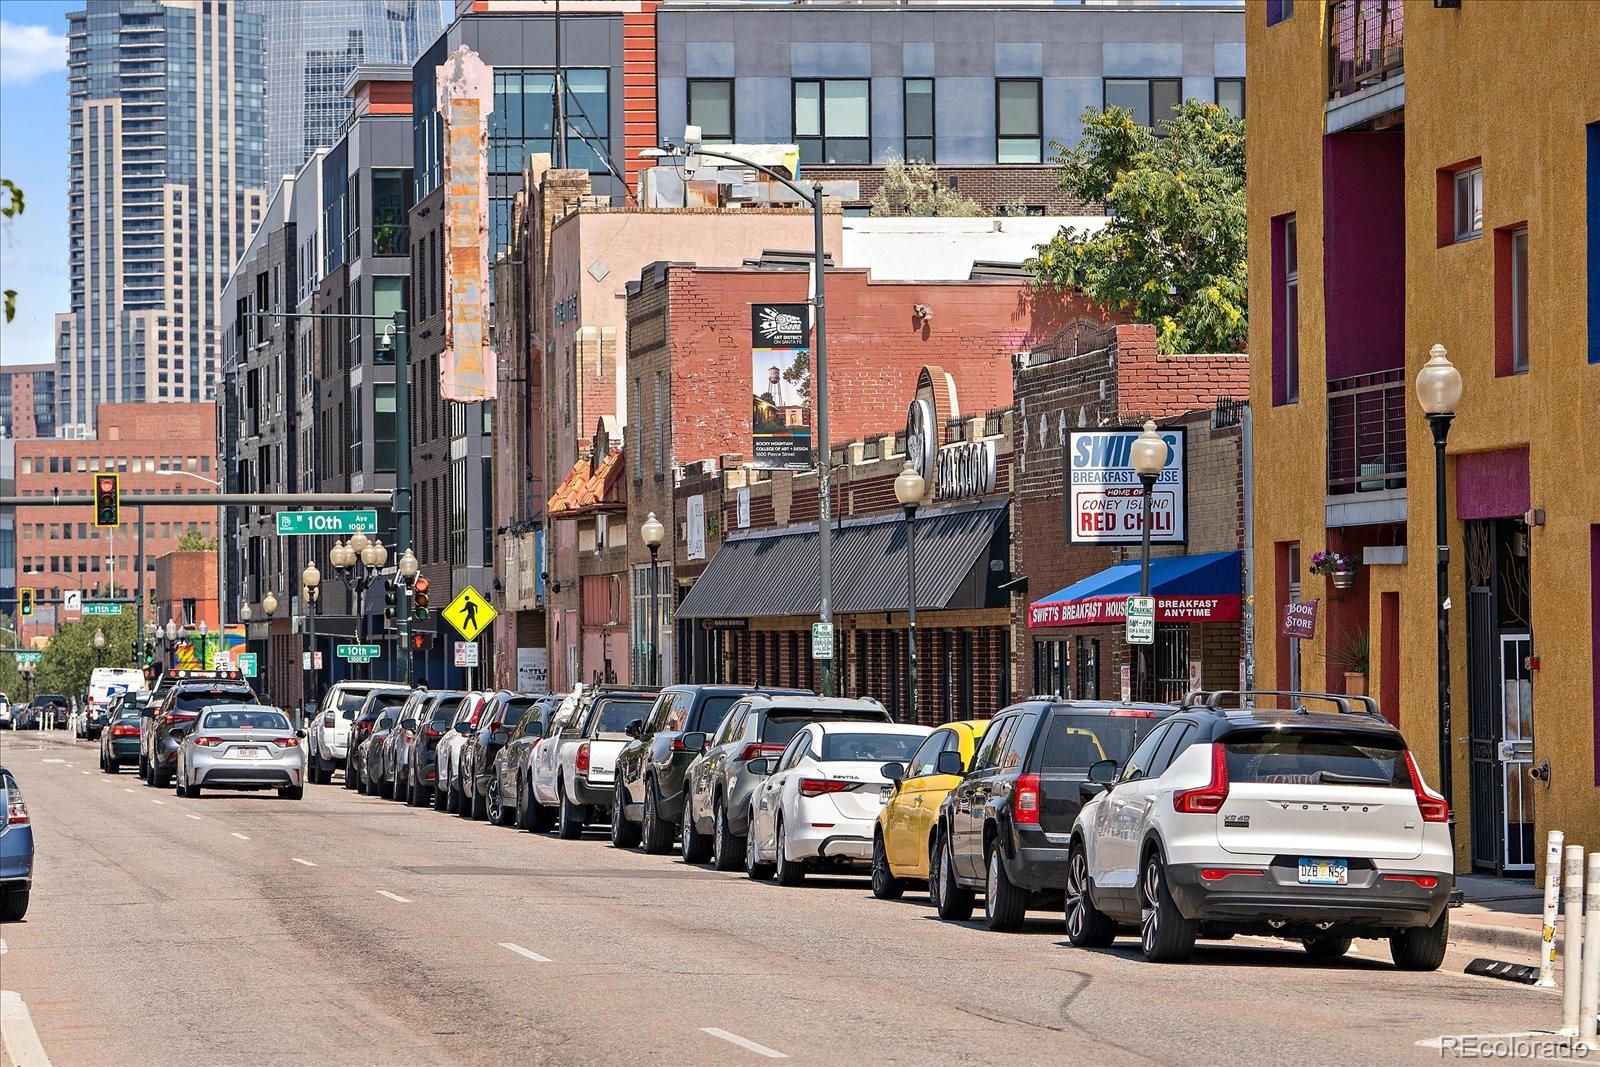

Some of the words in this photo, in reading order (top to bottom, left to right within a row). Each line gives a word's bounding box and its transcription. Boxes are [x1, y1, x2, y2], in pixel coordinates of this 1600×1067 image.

[1073, 434, 1177, 468] SWIFS
[936, 441, 989, 501] TATTOO
[1073, 471, 1134, 483] BREAKFAST
[1140, 471, 1178, 482] USE
[1082, 499, 1122, 511] CONEY
[1126, 499, 1169, 509] ISLND
[307, 515, 342, 530] 10th
[1081, 512, 1116, 531] RED
[1128, 599, 1134, 614] 2
[1139, 599, 1148, 607] HR
[1158, 600, 1218, 608] BREAKFAST
[1287, 603, 1314, 615] BOOK
[1032, 605, 1059, 623] SWIFT'S
[1062, 601, 1103, 621] BREAKFAST
[1164, 609, 1211, 617] ANYTIME
[1285, 615, 1313, 629] STORE
[347, 647, 366, 655] 10th
[216, 662, 228, 671] 25
[1281, 803, 1369, 812] VOLVO
